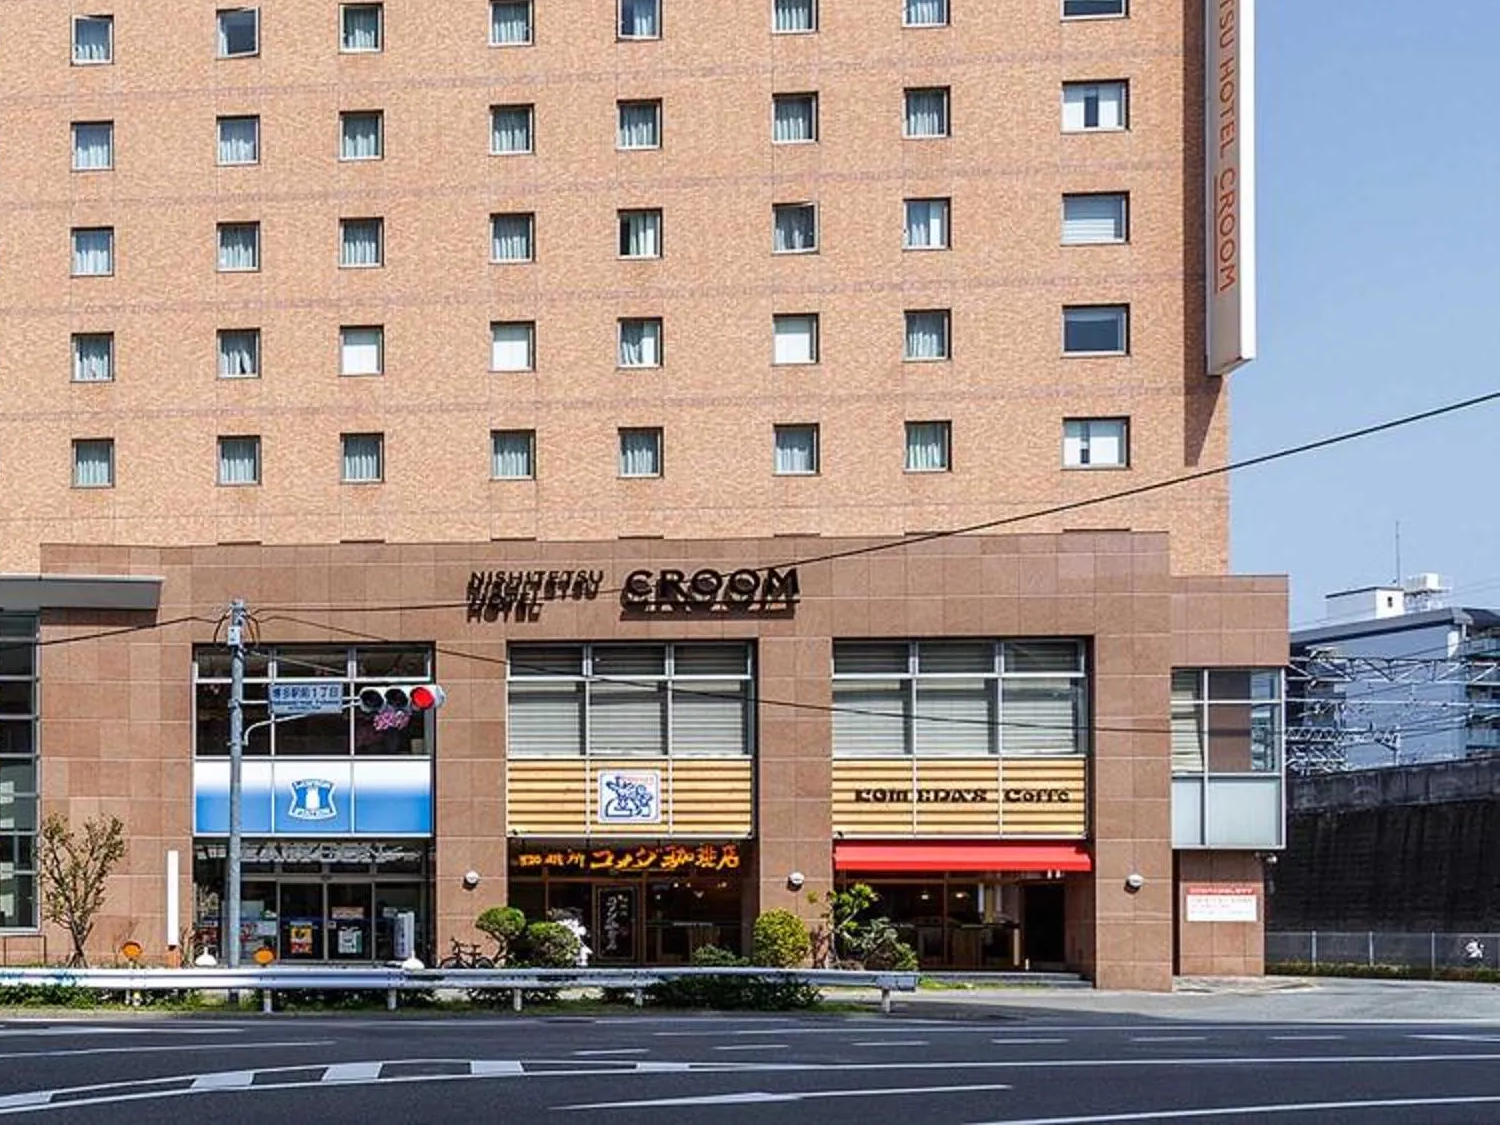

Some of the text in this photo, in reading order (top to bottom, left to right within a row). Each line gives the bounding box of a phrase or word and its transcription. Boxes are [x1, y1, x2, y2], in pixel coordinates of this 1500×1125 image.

[1219, 59, 1236, 159] HOTEL
[1218, 166, 1237, 292] CROOM
[626, 568, 800, 599] CROOM
